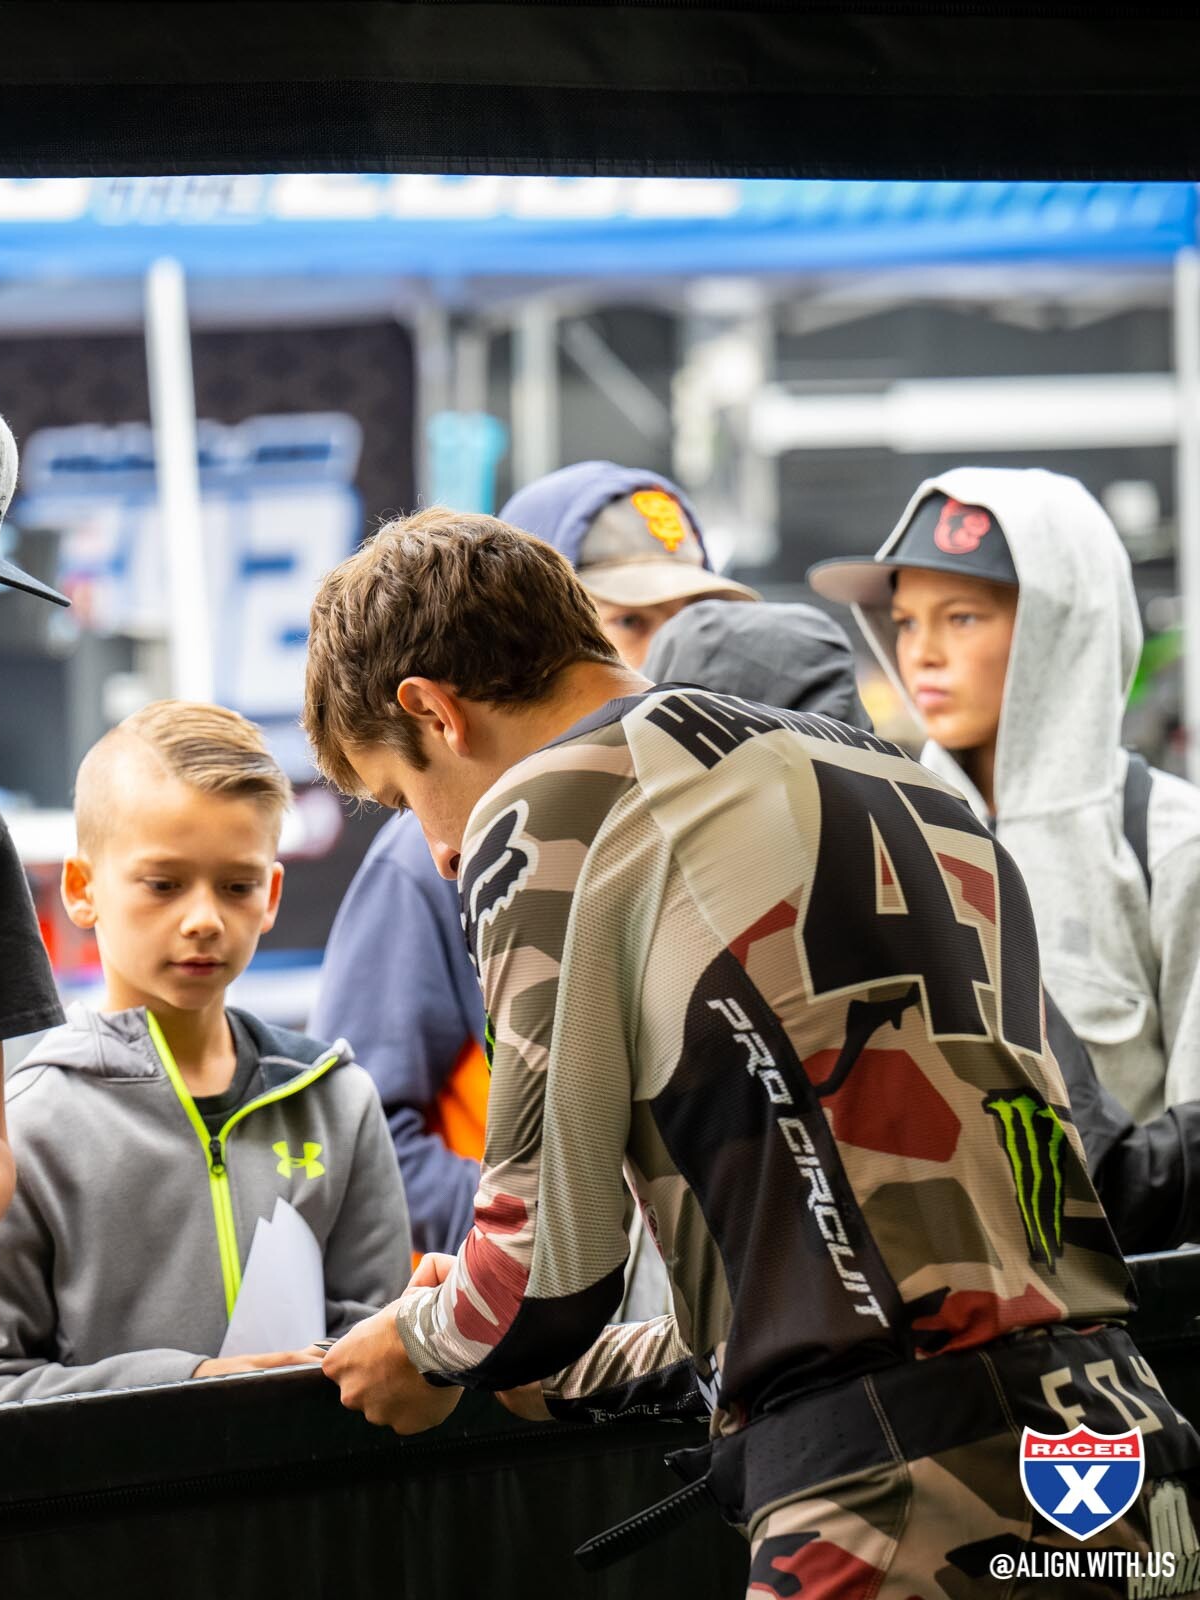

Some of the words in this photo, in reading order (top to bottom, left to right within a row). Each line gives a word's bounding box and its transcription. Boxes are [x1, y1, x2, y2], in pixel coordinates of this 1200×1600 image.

[796, 757, 1043, 1058] 47
[705, 998, 794, 1105] PRO
[777, 1117, 890, 1328] CIRCUIT
